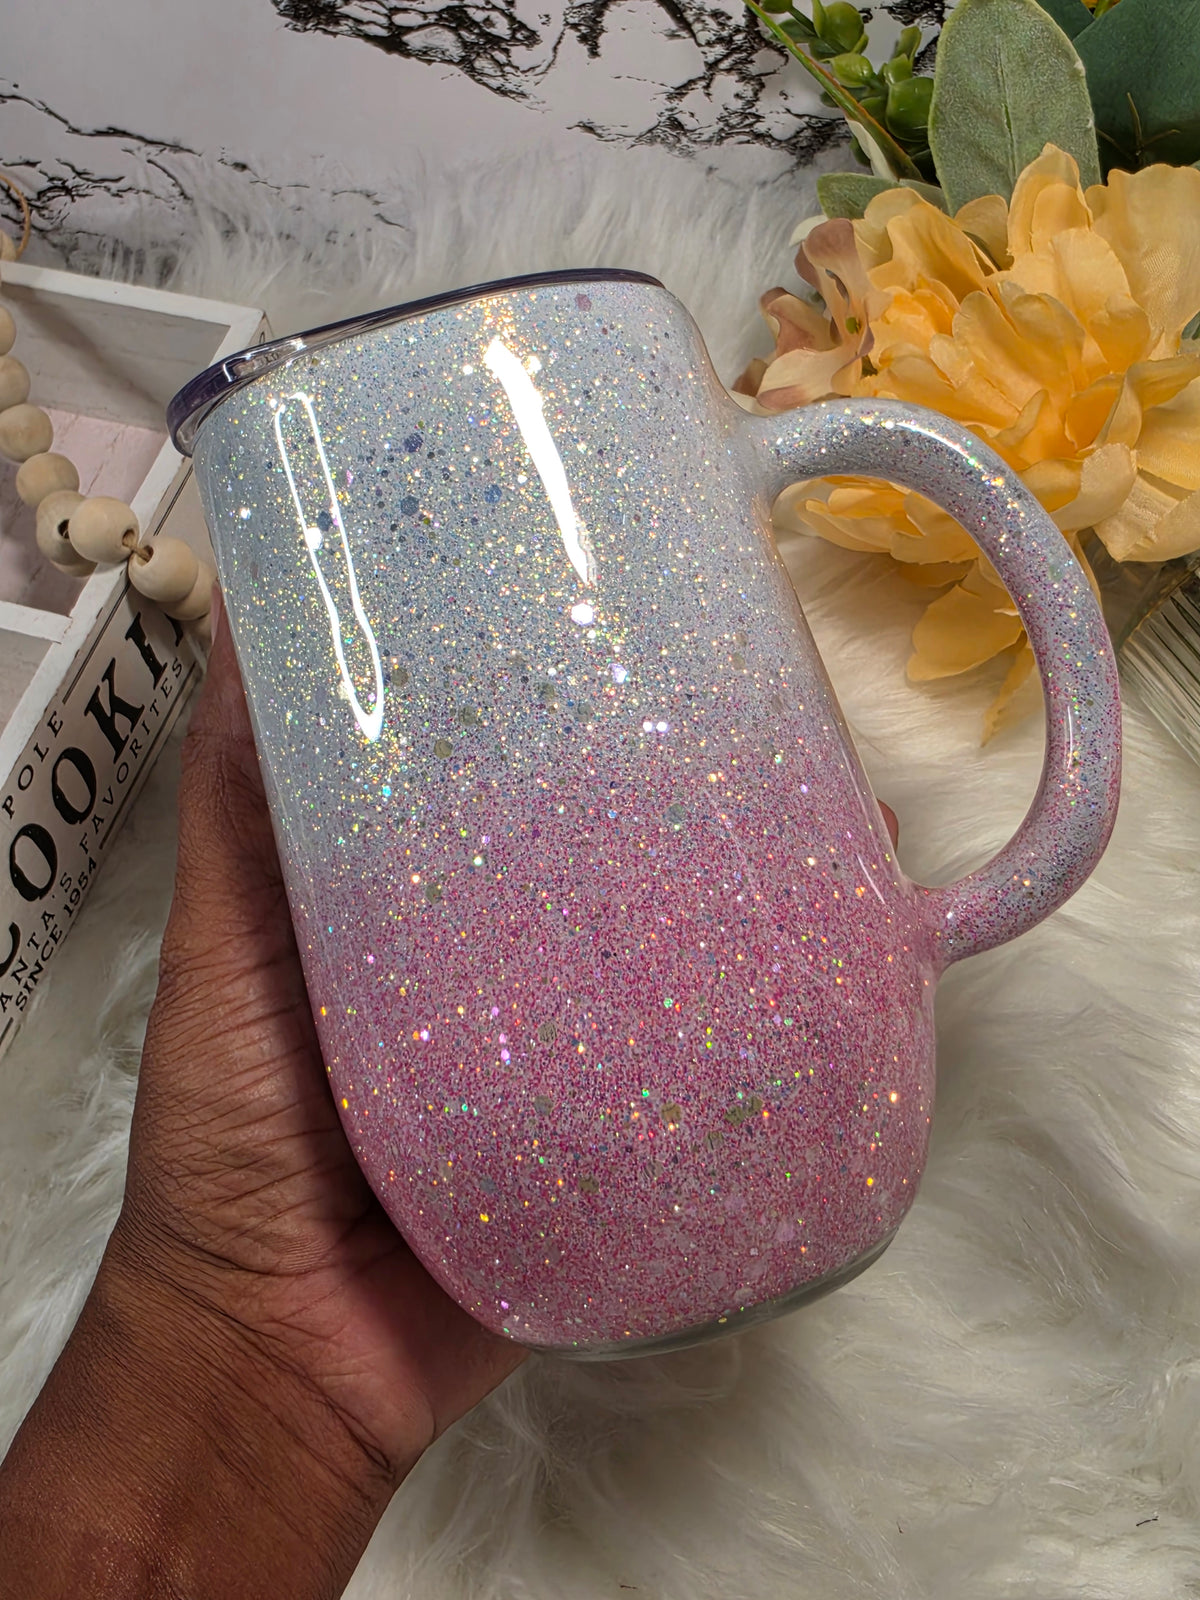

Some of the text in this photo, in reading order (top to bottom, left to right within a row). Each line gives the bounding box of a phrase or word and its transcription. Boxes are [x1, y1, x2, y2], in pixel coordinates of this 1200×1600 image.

[0, 611, 184, 977] OOKI
[2, 711, 63, 819] POLE
[79, 657, 183, 855] FAVORITES
[15, 857, 97, 1012] SINCE 1954
